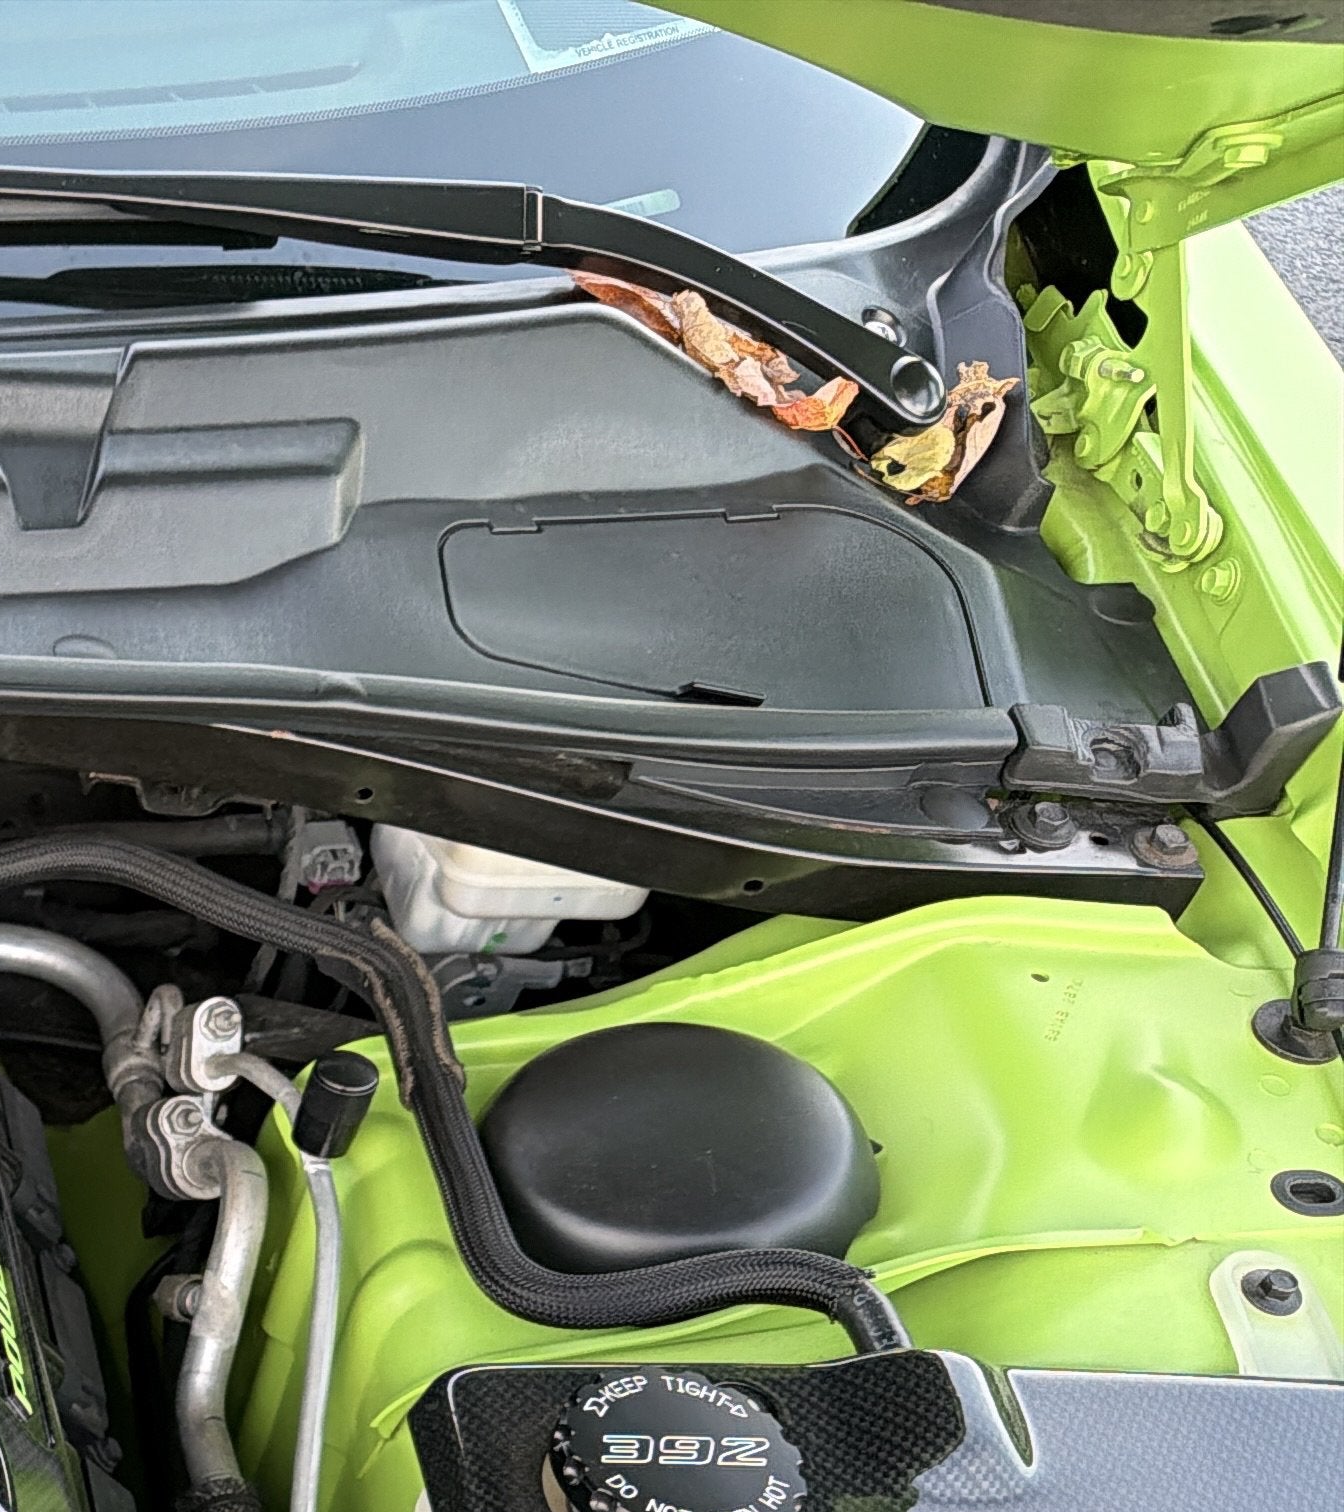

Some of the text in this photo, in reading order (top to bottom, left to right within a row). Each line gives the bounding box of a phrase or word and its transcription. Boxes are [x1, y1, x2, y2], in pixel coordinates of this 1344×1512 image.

[574, 25, 679, 58] VEHICLE REGISTRATION
[601, 1375, 731, 1409] KEEP TIGHT
[600, 1434, 771, 1467] 392
[605, 1473, 639, 1500] DO
[759, 1475, 791, 1511] HOT
